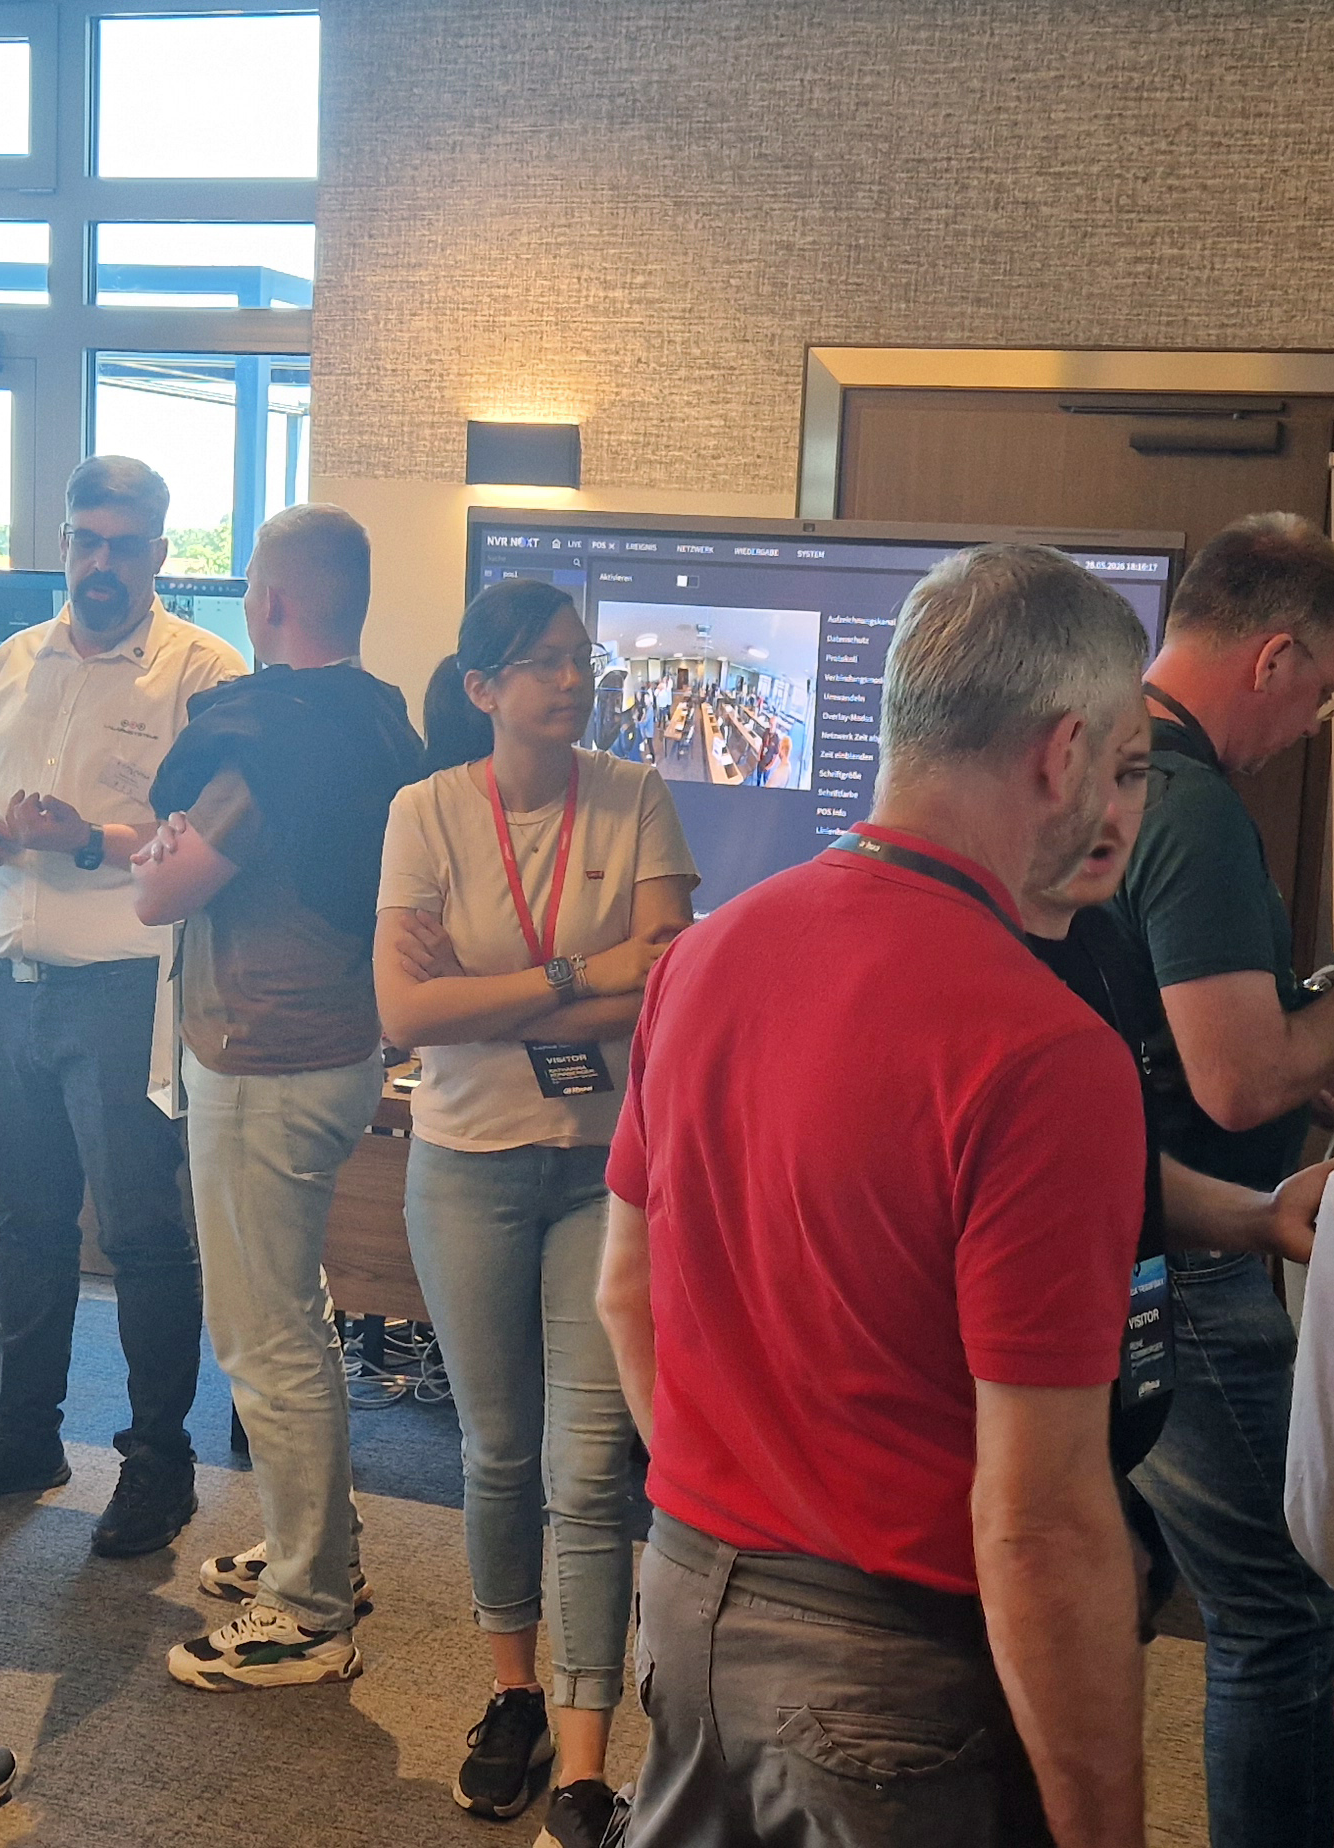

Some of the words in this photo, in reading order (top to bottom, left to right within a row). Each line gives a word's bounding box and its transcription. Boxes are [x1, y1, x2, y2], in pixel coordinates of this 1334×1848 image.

[486, 535, 508, 547] NVR
[567, 540, 583, 549] LIVE
[591, 541, 607, 550] POS
[676, 544, 715, 554] NETZWERK
[796, 549, 826, 559] SYSTEM
[854, 732, 868, 743] Zeit
[819, 750, 834, 759] Zeit
[816, 807, 831, 817] POS
[545, 1053, 588, 1065] VISITOR
[1128, 1307, 1160, 1330] VISITOR
